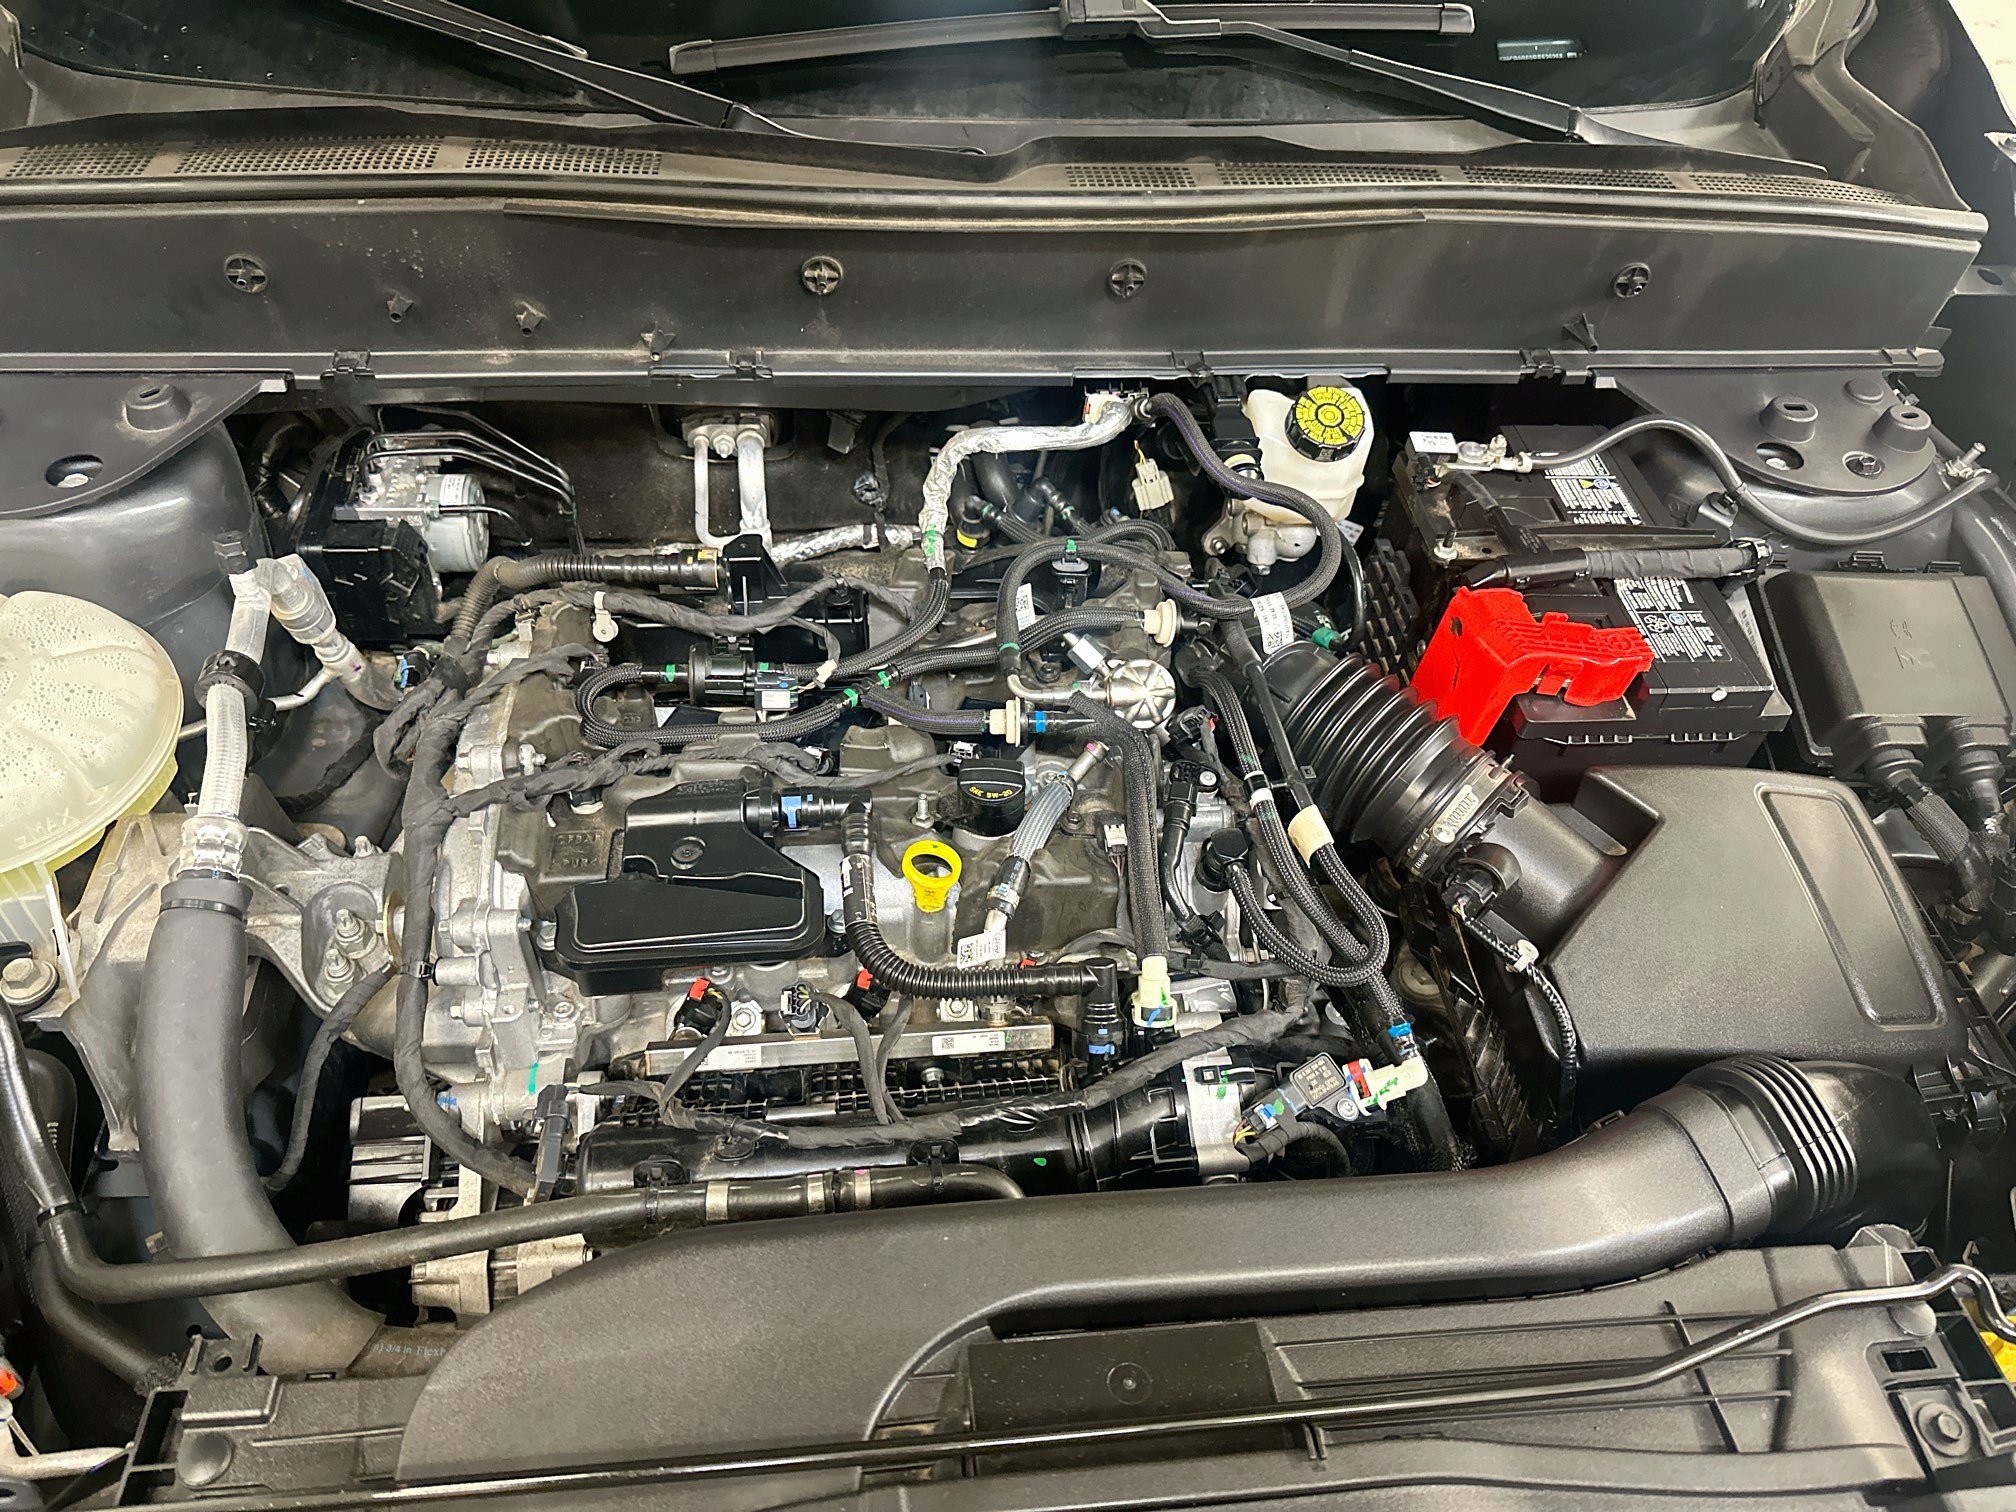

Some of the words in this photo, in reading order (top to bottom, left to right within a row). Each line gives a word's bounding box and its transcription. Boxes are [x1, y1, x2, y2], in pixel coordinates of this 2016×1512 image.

[969, 786, 984, 797] SAE
[986, 789, 1013, 798] 5W-20
[385, 1343, 401, 1353] 3/4
